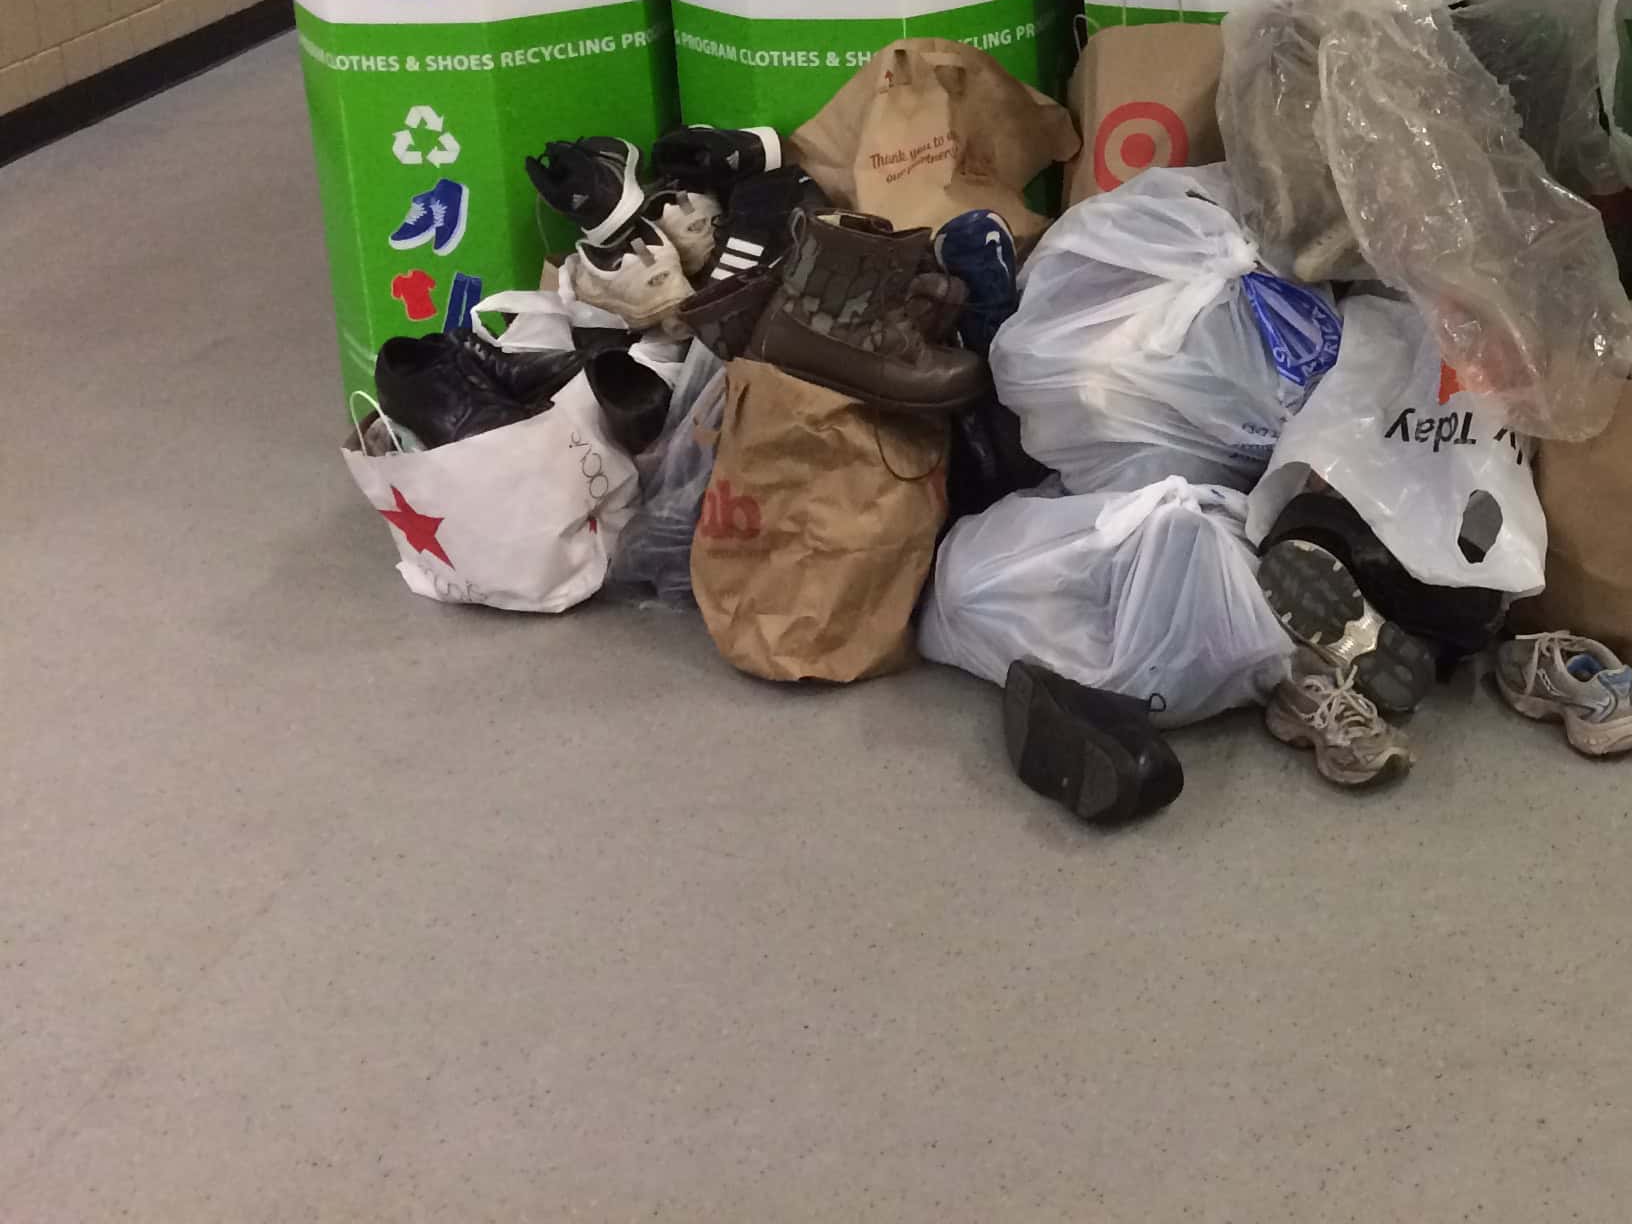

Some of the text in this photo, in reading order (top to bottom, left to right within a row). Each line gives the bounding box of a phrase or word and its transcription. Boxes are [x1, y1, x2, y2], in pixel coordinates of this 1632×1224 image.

[406, 55, 421, 72] &
[426, 54, 494, 72] SHOES
[501, 36, 615, 68] RECYCLING
[621, 28, 657, 49] PRO
[740, 48, 820, 68] CLOTHES
[825, 51, 840, 67] &
